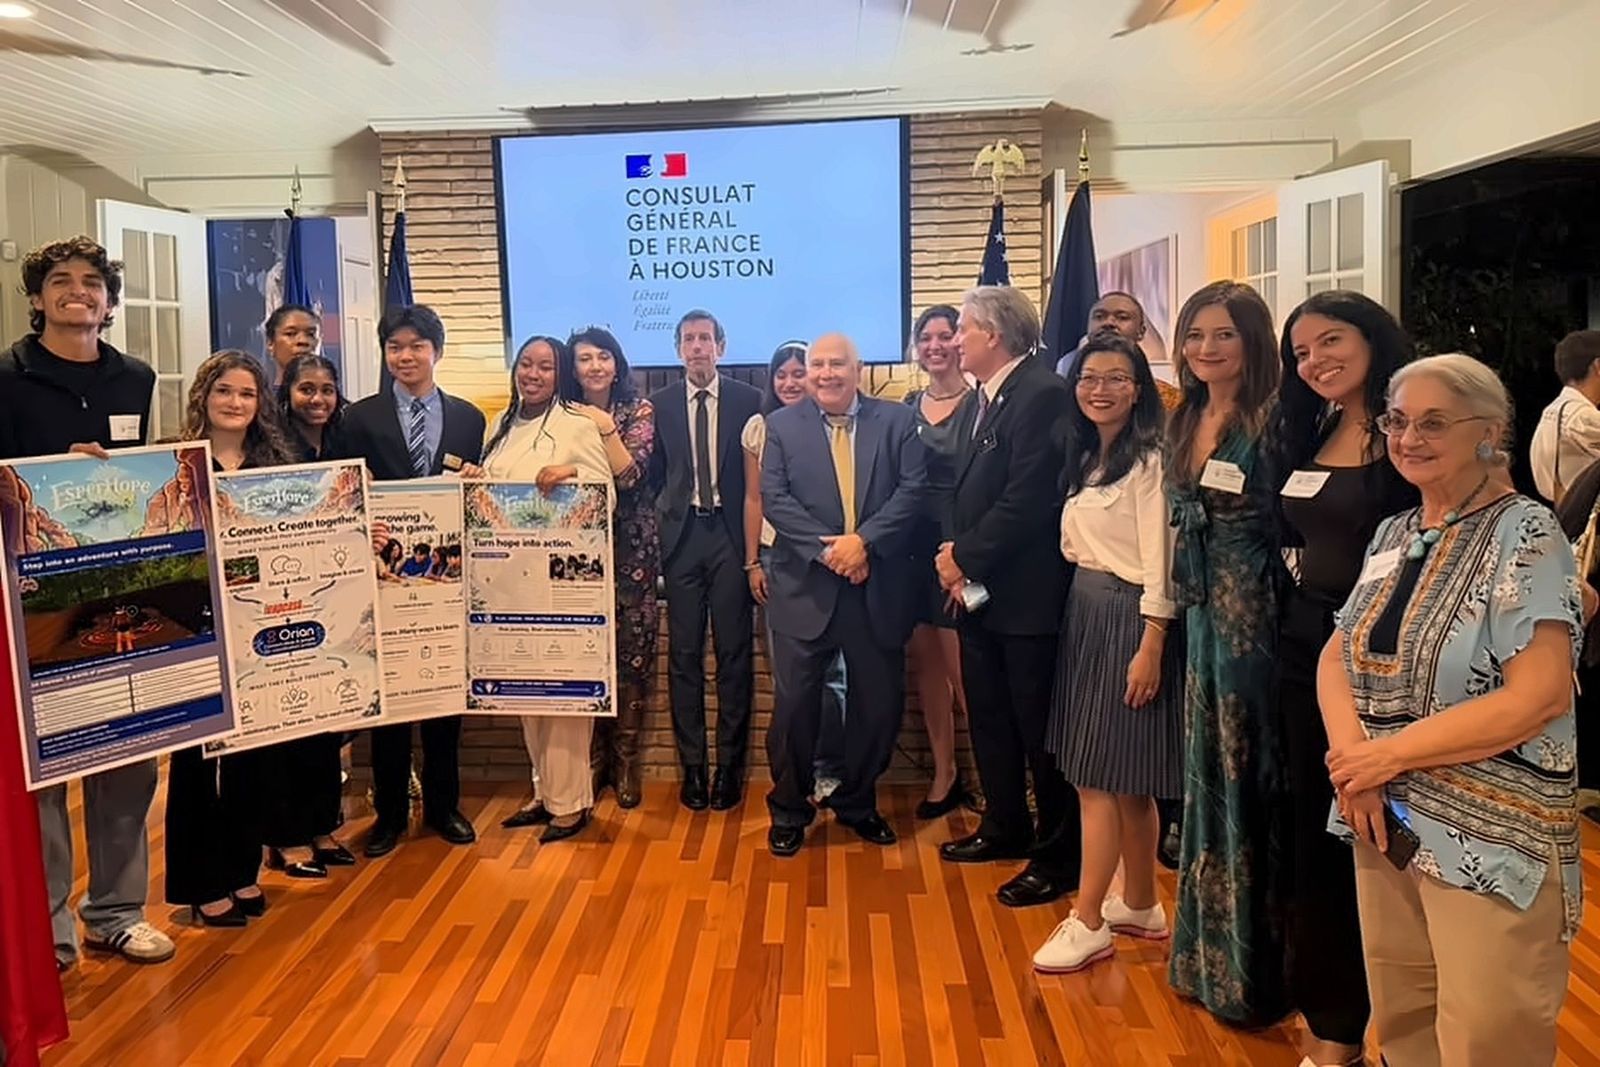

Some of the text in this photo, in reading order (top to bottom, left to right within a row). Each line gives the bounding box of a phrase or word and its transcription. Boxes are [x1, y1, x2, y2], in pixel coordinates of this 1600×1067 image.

[626, 184, 756, 207] CONSULAT
[626, 207, 737, 232] GÉNÉRAL
[629, 234, 761, 256] DE FRANCE
[629, 258, 773, 280] À HOUSTON
[228, 524, 276, 538] Connect.
[277, 521, 315, 532] Create
[474, 538, 495, 547] Turn
[496, 538, 520, 548] hope
[522, 538, 541, 547] into
[279, 627, 314, 640] Orion
